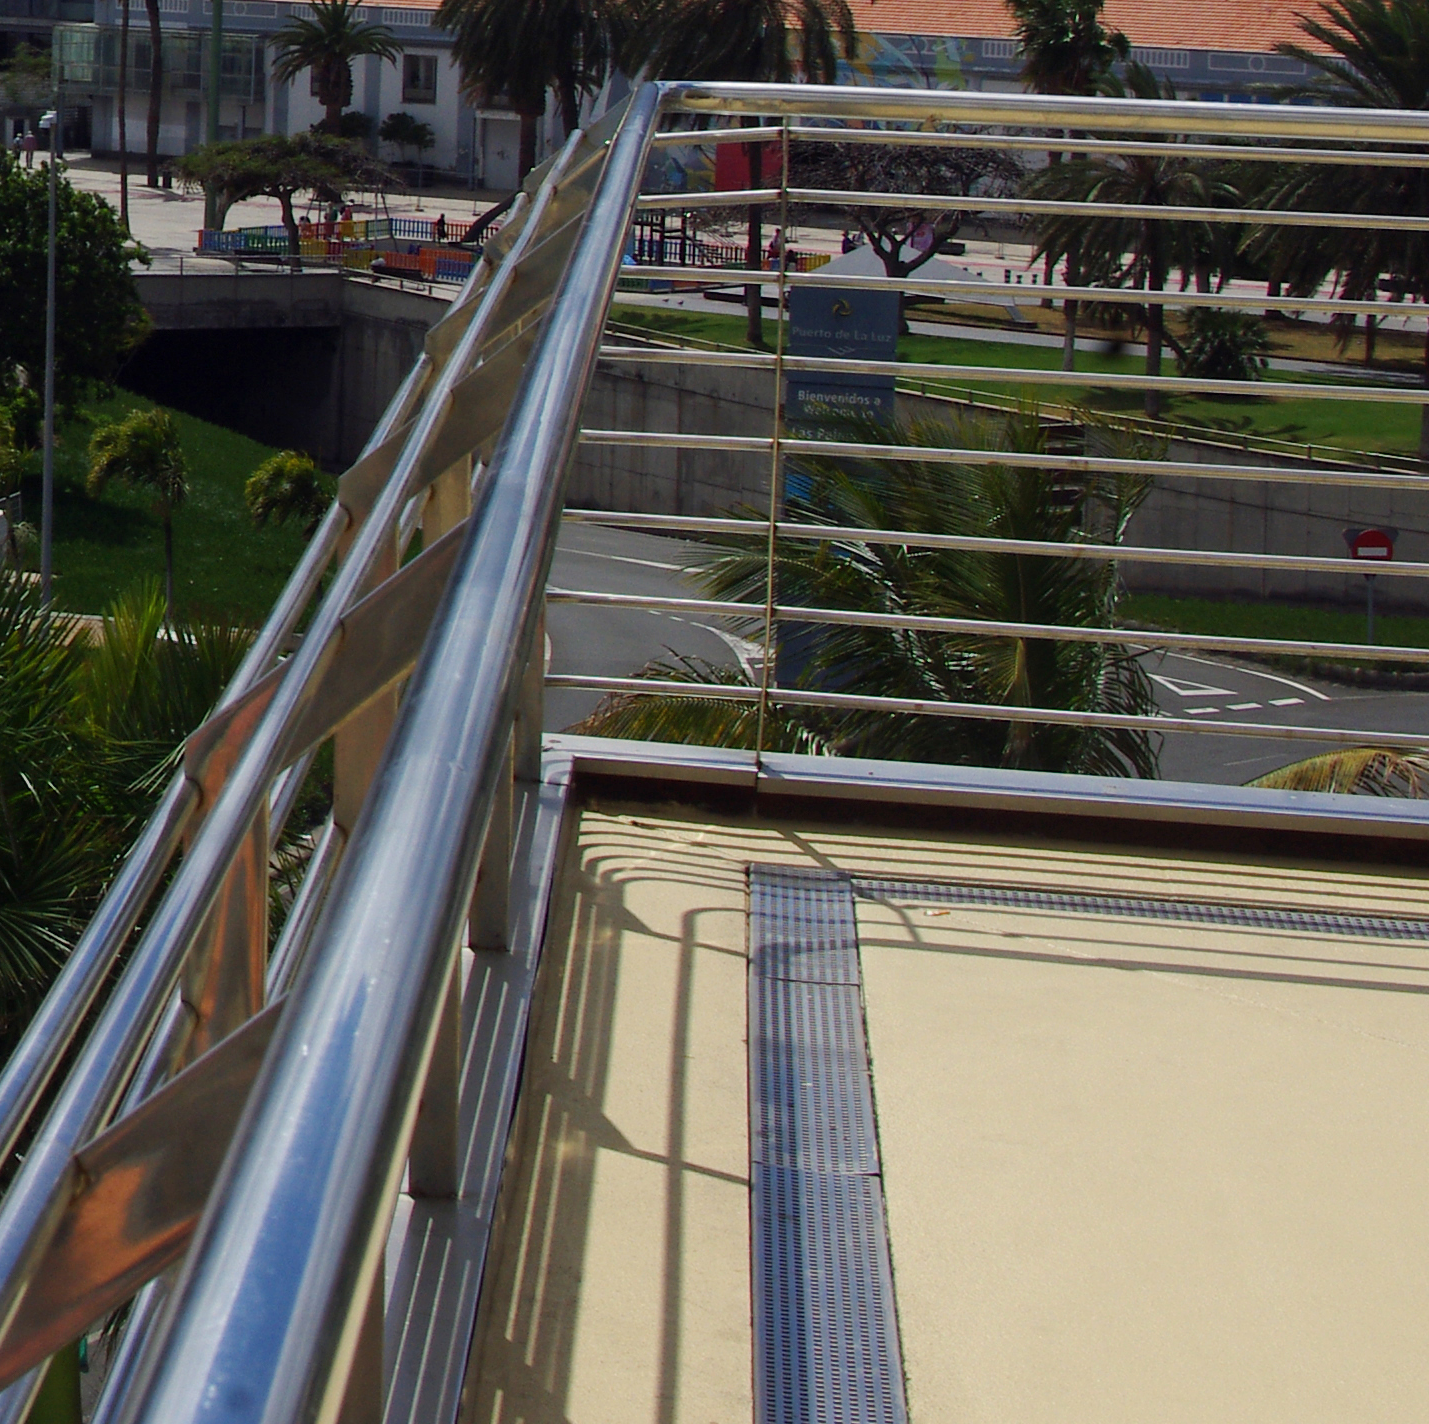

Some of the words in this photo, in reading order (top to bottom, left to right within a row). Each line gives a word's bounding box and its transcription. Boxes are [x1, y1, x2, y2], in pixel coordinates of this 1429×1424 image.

[792, 326, 832, 339] Puerto
[835, 329, 850, 341] de
[854, 330, 867, 342] La
[871, 331, 893, 343] Luz
[797, 389, 870, 406] Bienvenidos
[873, 396, 882, 406] a
